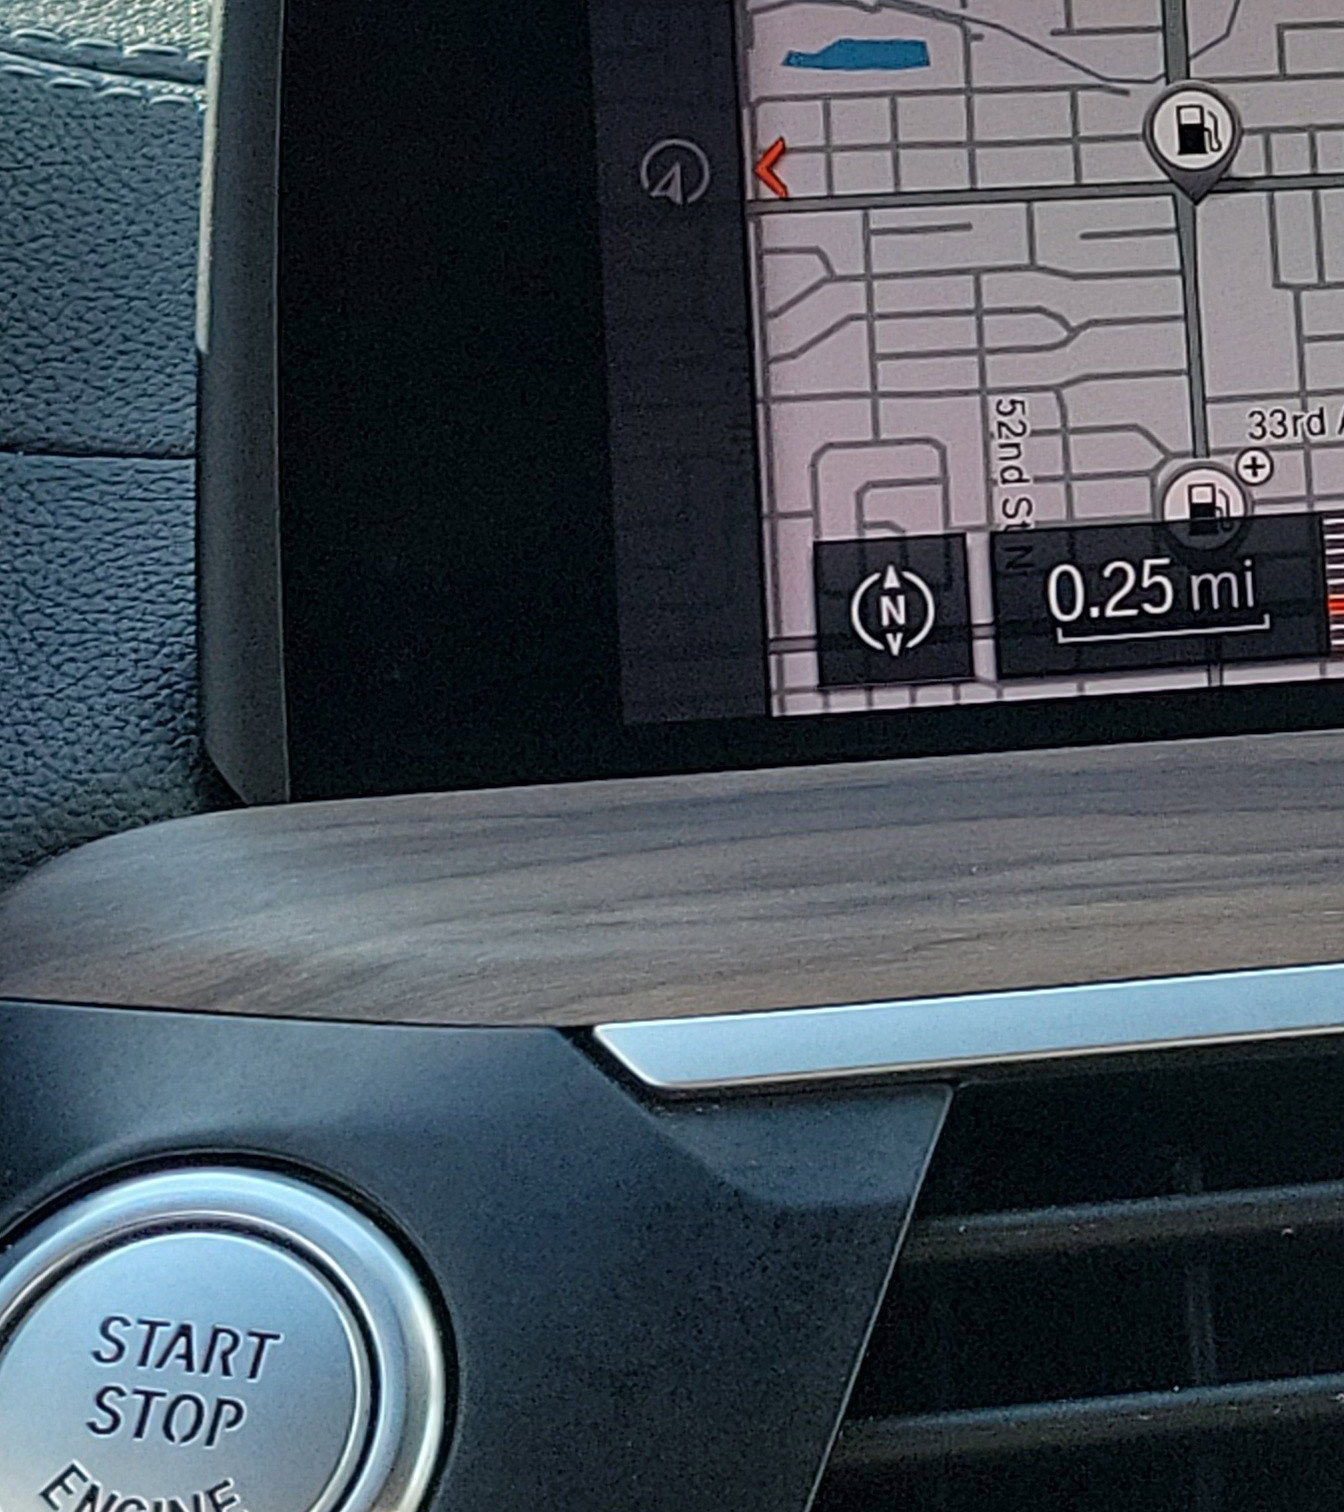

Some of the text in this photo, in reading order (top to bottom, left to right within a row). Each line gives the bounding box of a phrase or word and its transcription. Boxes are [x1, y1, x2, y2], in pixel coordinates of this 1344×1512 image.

[996, 399, 1030, 485] 52nd
[1248, 409, 1326, 440] 33rd
[879, 594, 905, 626] N
[1047, 558, 1254, 621] 0.25 mi
[91, 1315, 281, 1380] START
[87, 1386, 246, 1448] STOP
[39, 1462, 240, 1511] ENE
